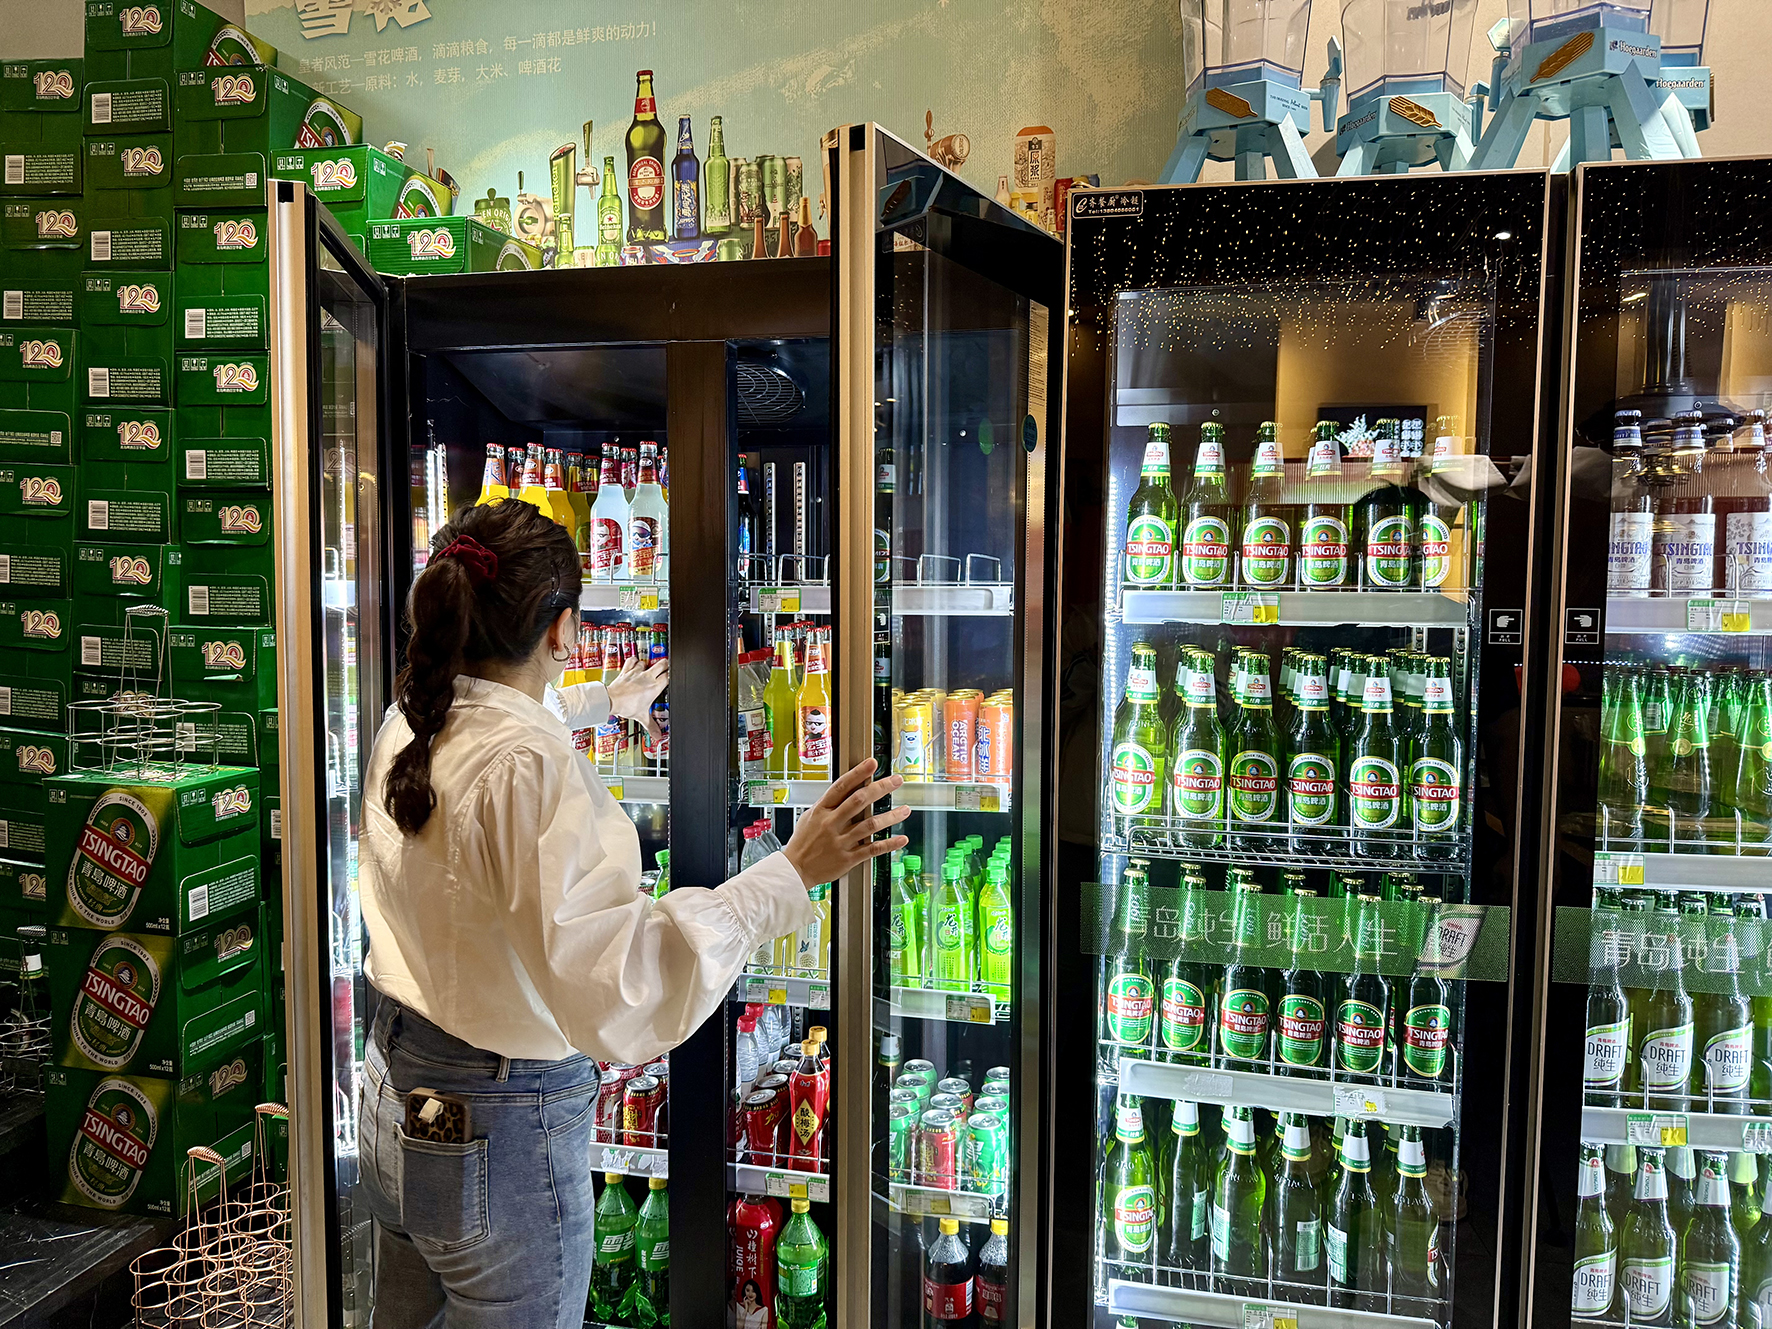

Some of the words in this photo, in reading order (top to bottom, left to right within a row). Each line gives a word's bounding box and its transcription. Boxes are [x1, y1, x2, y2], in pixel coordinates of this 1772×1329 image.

[1619, 40, 1658, 58] Hoegaarden
[1656, 77, 1705, 90] Hoegaarden
[1127, 544, 1170, 555] TSINGTAO
[1184, 545, 1228, 556] TSINGTAO
[1244, 545, 1289, 556] TSINGTAO
[1302, 545, 1347, 556] TSINGTAO
[951, 719, 961, 762] OCEAN
[959, 719, 969, 765] ARCTIC
[978, 725, 991, 773] 北冰洋
[1176, 775, 1221, 789] TSINGTAO
[1231, 777, 1276, 790] TSINGTAO
[1289, 780, 1334, 793] TSINGTAO
[1351, 784, 1398, 797] TSINGTAO
[82, 829, 147, 882] TSINGTAO
[1266, 911, 1398, 955] 鲜活人生
[1602, 930, 1746, 974] 青岛纯生
[85, 971, 150, 1024] TSINGTAO
[1110, 995, 1151, 1010] TSINGTAO
[1163, 1000, 1201, 1017] TSINGTAO
[1223, 1010, 1267, 1025] TSINGTAO
[1279, 1016, 1322, 1032] TSINGTAO
[1337, 1022, 1382, 1039] TSINGTAO
[1409, 1027, 1448, 1041] TSINGTAO
[1587, 1042, 1622, 1058] DRAFT
[1650, 1047, 1686, 1063] DRAFT
[1715, 1049, 1749, 1064] DRAFT
[1593, 1058, 1616, 1072] 纯生
[1655, 1062, 1680, 1077] 纯生
[1721, 1063, 1744, 1078] 纯生
[800, 1107, 811, 1139] 酸梅汤
[83, 1112, 148, 1165] TSINGTAO
[1580, 1272, 1612, 1287] DRAFT
[1625, 1272, 1661, 1296] DRAFT
[1683, 1275, 1718, 1297] DRAFT
[1586, 1288, 1608, 1302] 纯生
[1630, 1291, 1654, 1309] 纯生
